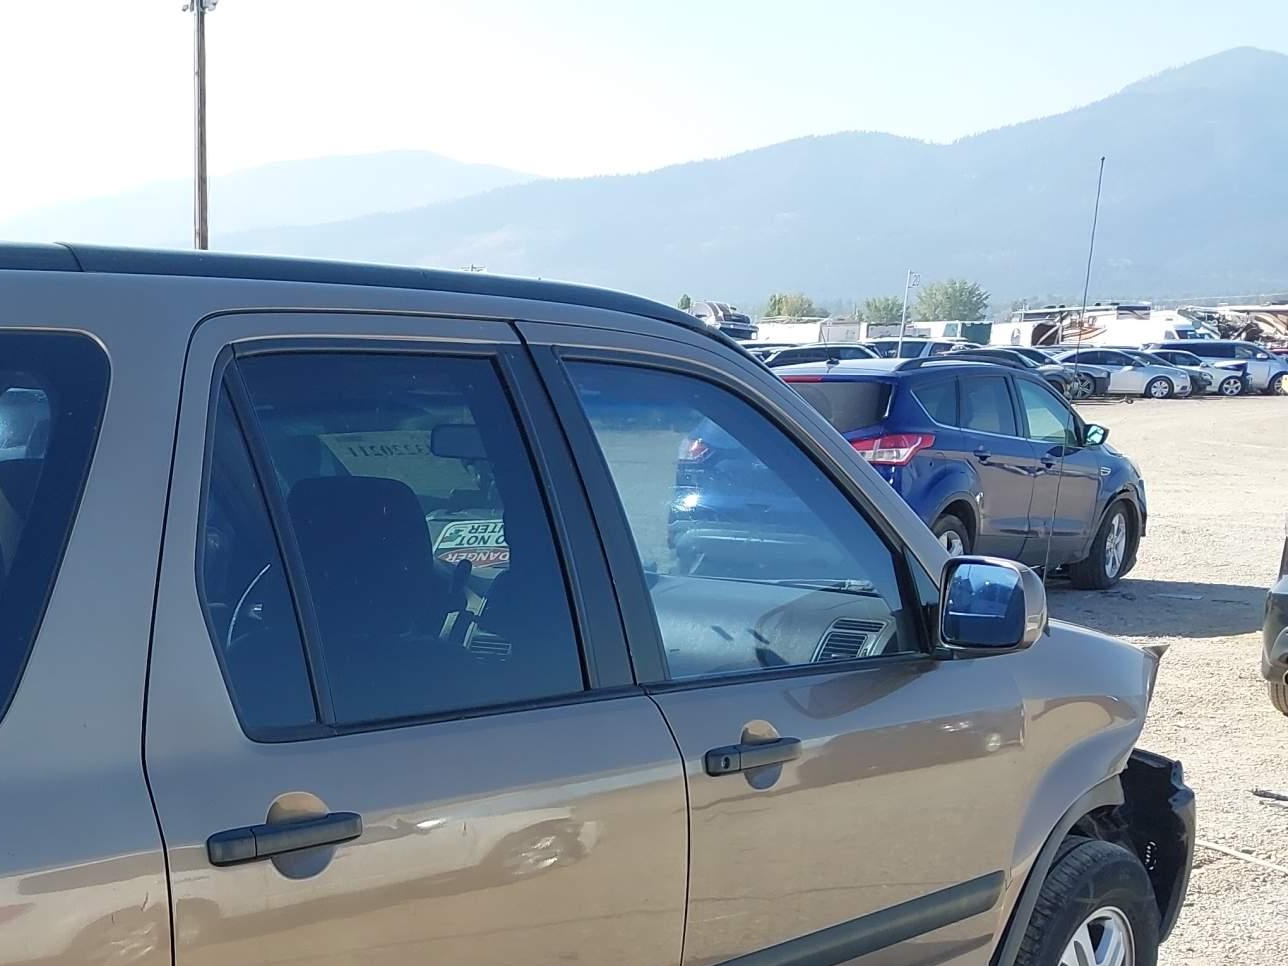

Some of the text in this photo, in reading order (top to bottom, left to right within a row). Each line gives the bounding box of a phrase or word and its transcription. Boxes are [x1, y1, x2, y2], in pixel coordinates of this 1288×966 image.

[467, 523, 504, 535] TER
[455, 534, 491, 546] NOT
[445, 551, 510, 563] DANGER
